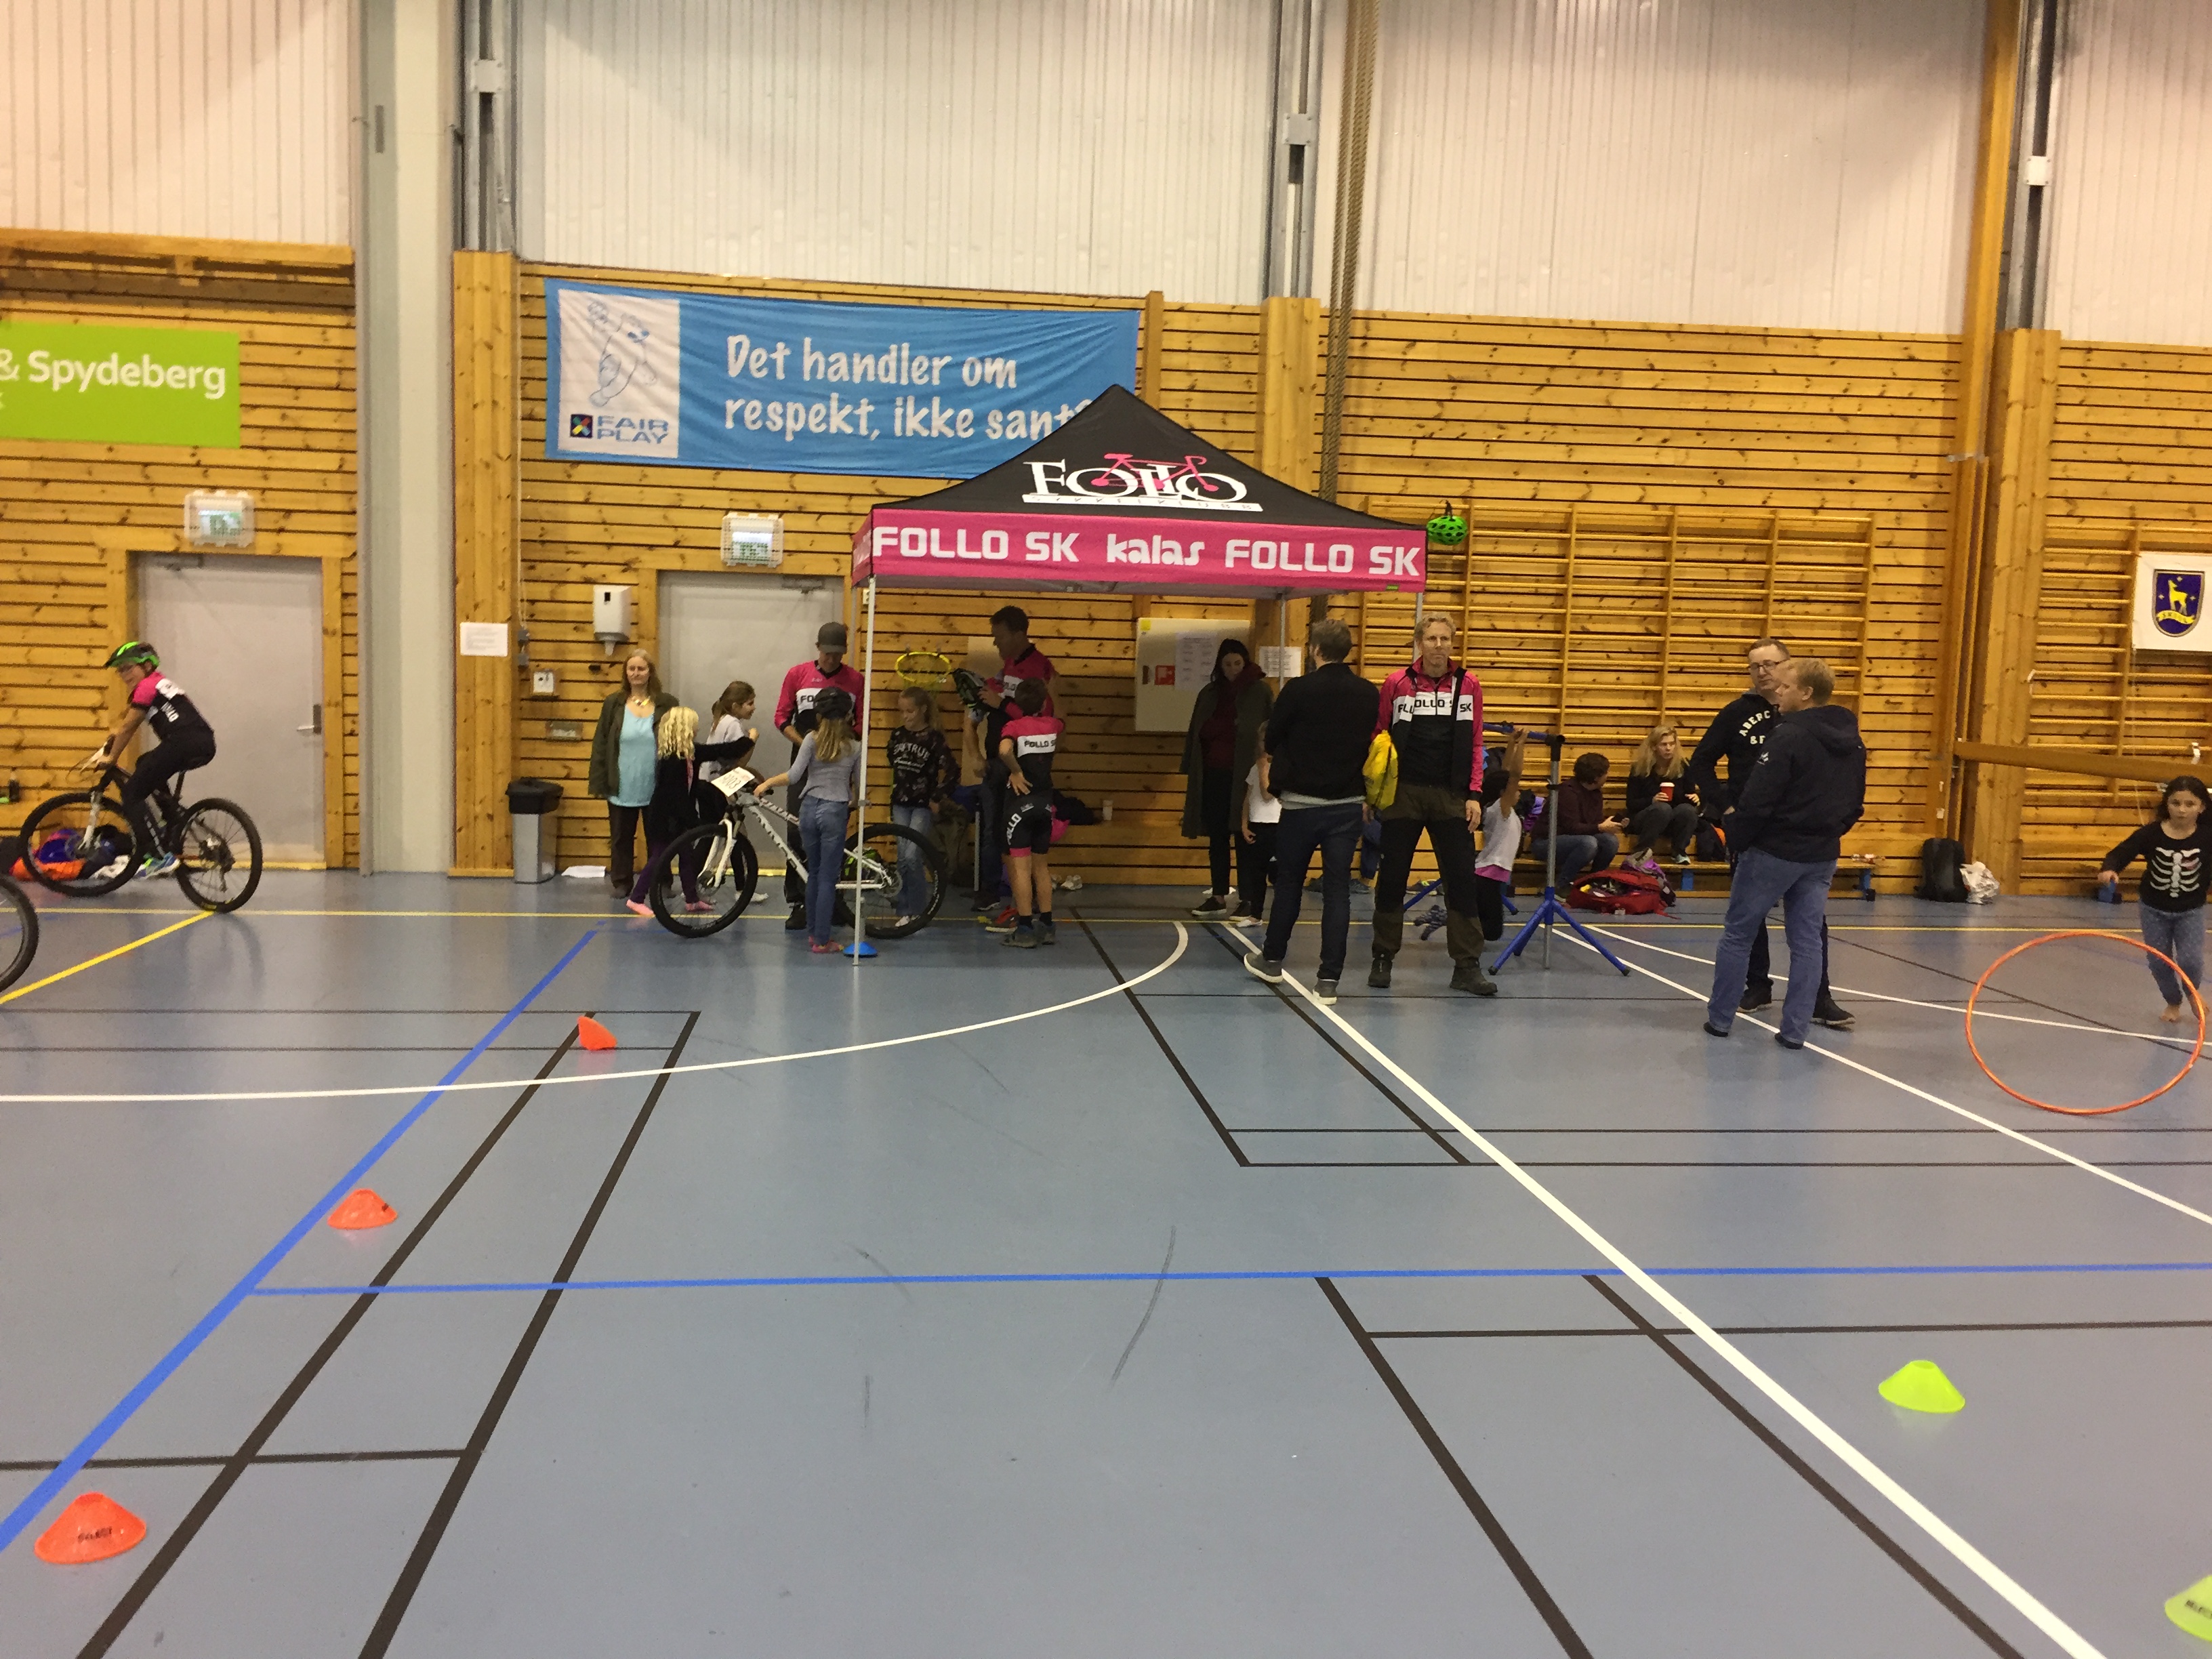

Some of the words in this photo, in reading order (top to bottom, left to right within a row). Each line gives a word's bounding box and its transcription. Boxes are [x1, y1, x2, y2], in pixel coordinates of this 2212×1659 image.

[28, 350, 226, 400] Spydeberg
[727, 334, 791, 380] Det
[803, 337, 953, 385] handler
[962, 356, 1017, 389] om
[597, 415, 669, 432] FAIR
[725, 392, 880, 442] respekt,
[895, 395, 975, 438] ikke
[597, 428, 668, 444] PLAY
[872, 526, 1009, 560] FOLLO
[1025, 531, 1080, 562] SK
[1107, 533, 1204, 567] kalas
[1225, 539, 1355, 573] FOLLO
[1369, 546, 1420, 576] SK
[1460, 703, 1472, 712] SK
[1024, 740, 1049, 748] FOLLO
